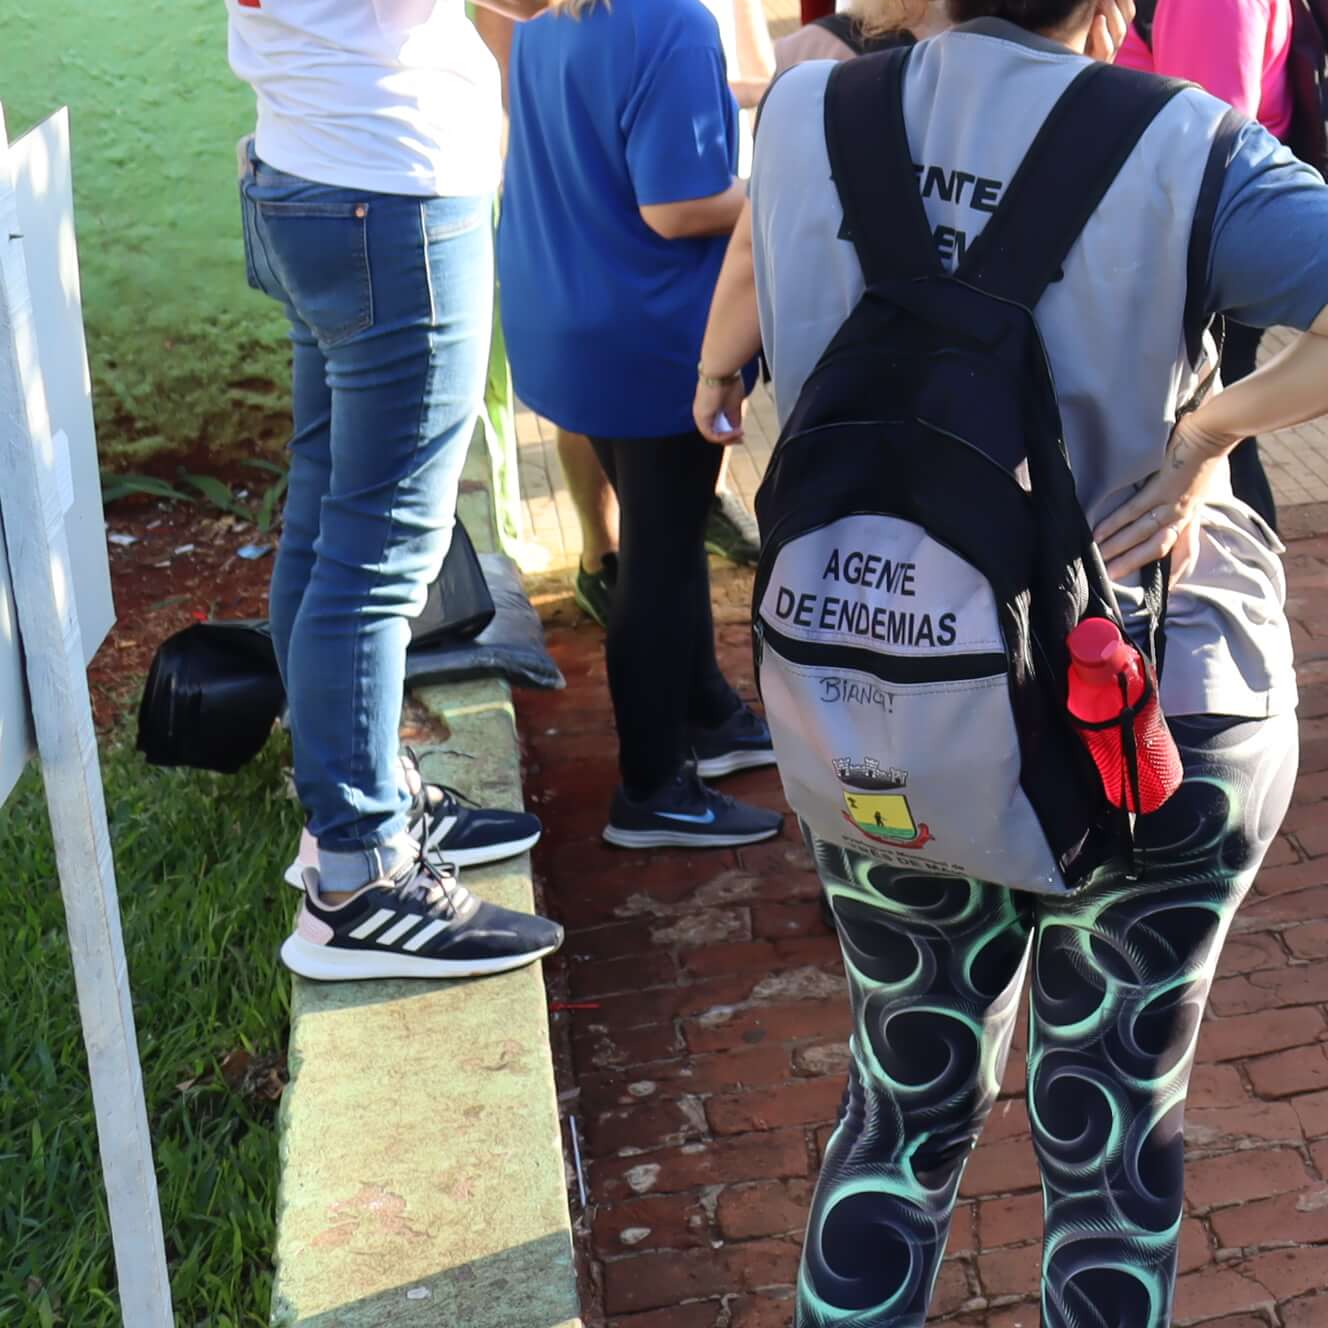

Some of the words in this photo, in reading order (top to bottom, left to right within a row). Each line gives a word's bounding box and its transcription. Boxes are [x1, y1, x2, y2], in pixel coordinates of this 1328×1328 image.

[822, 548, 916, 597] AGENTE
[775, 586, 817, 627] DE
[819, 596, 957, 648] ENDEMIAS
